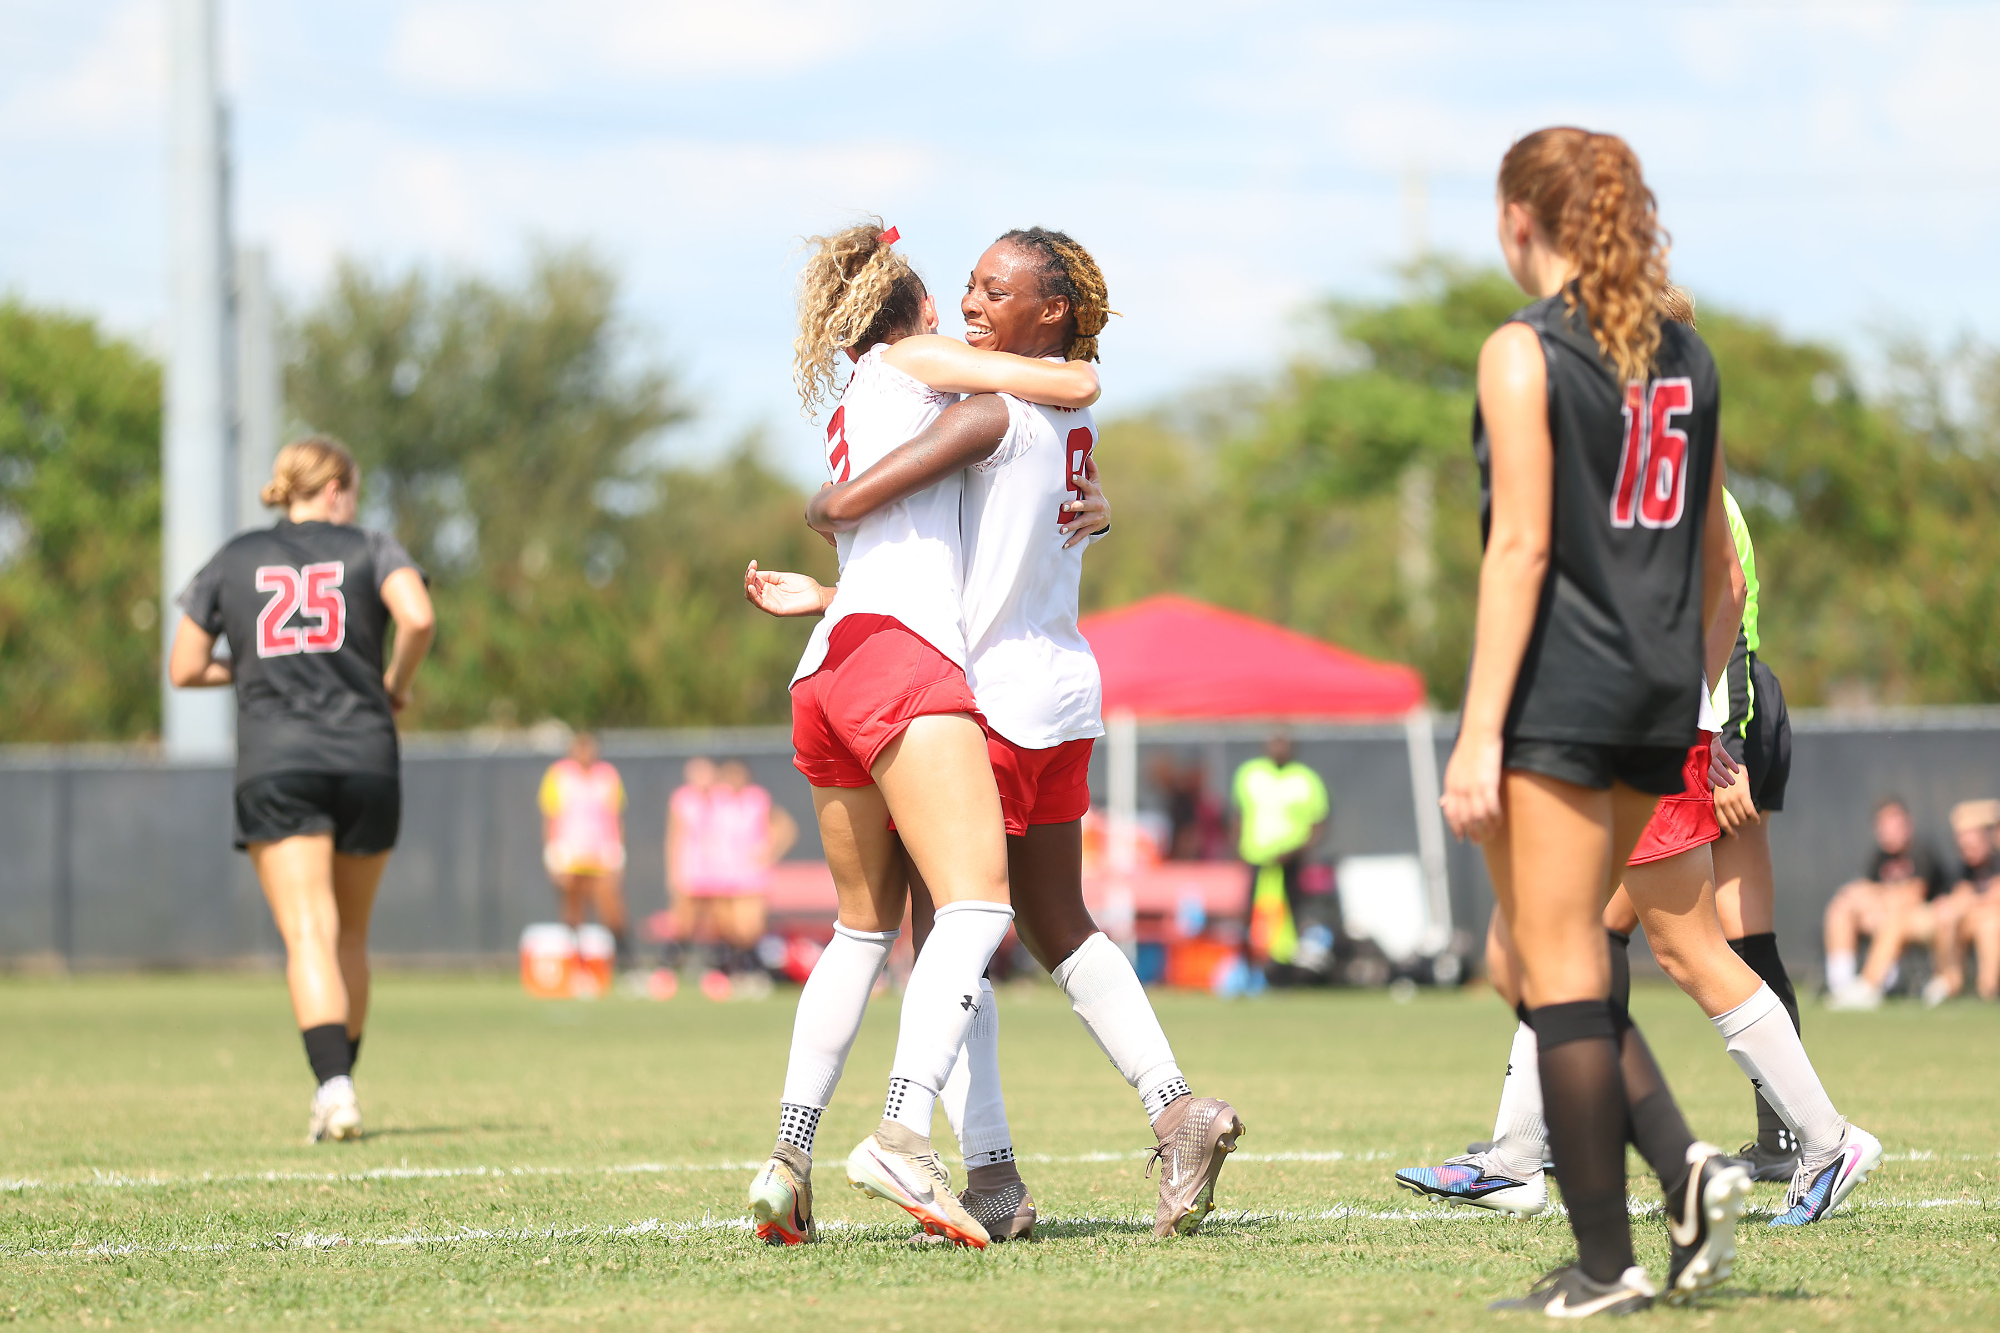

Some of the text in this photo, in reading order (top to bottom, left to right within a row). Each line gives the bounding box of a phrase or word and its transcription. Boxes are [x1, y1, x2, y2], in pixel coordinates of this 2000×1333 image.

[1057, 426, 1093, 525] 9
[1610, 376, 1693, 529] 16
[256, 560, 346, 658] 25
